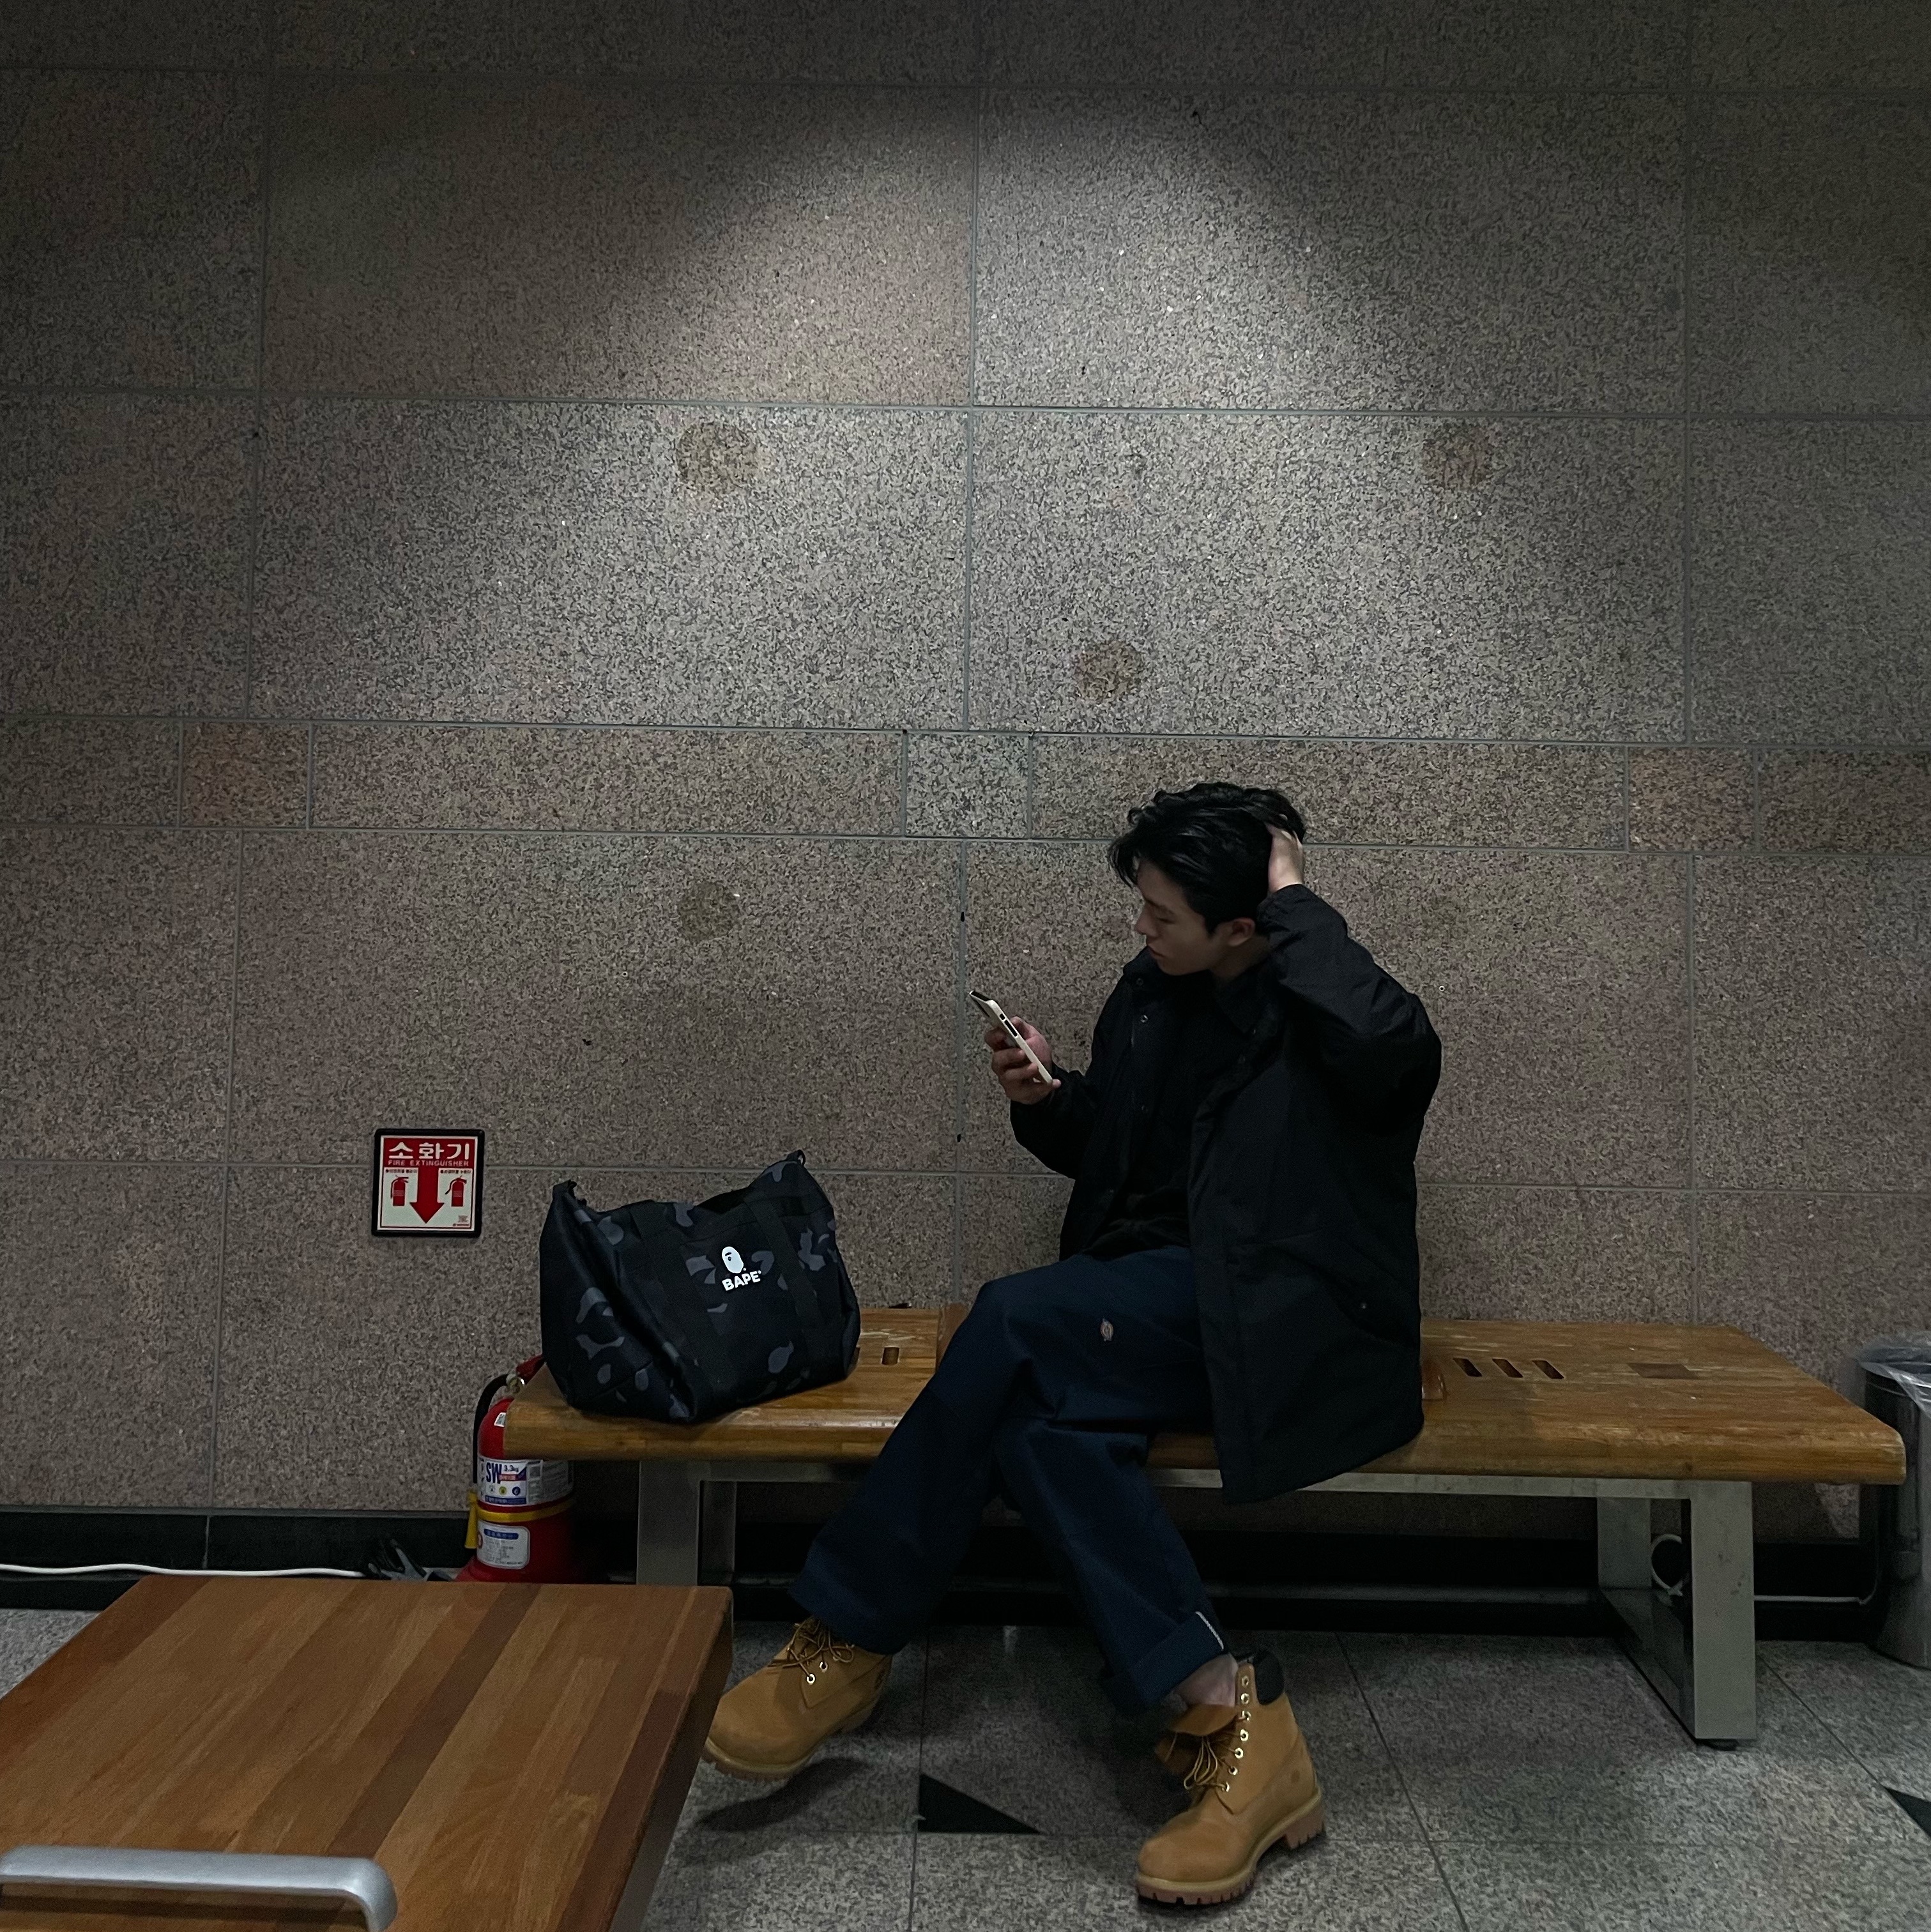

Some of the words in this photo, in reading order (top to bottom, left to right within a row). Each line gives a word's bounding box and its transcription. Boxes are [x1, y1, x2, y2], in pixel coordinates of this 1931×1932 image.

[388, 1142, 469, 1160] 소화기
[722, 1271, 761, 1291] BAPE
[486, 1463, 502, 1484] SW
